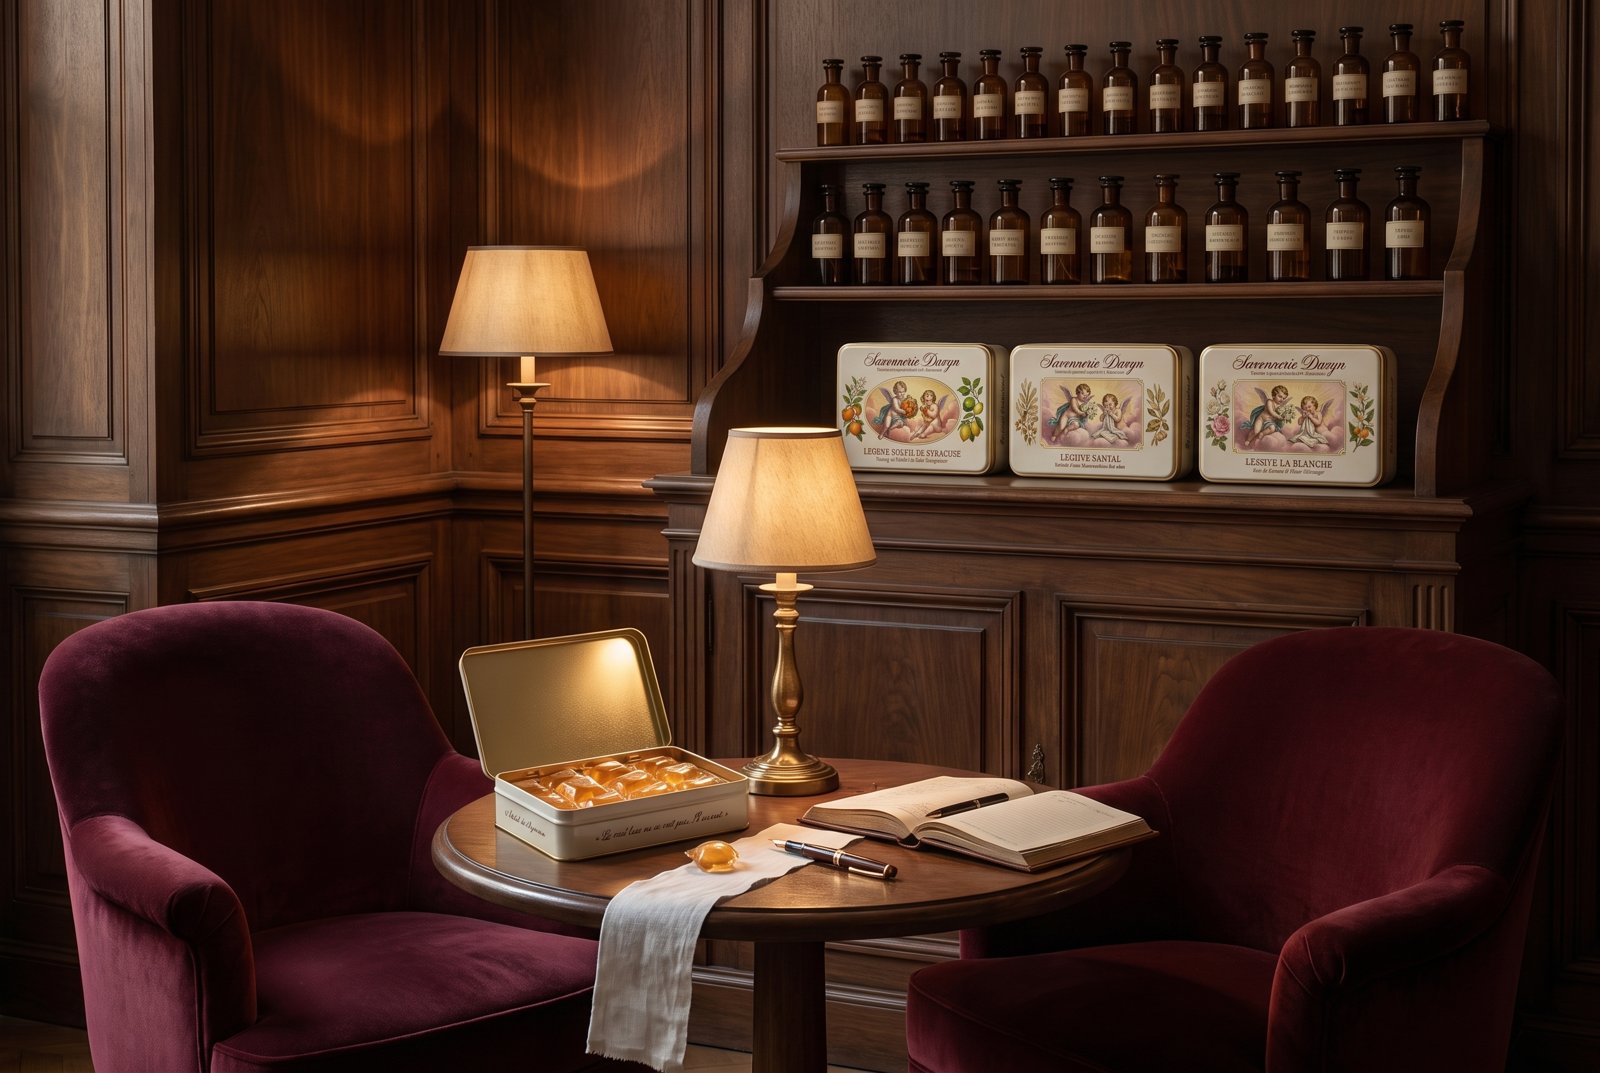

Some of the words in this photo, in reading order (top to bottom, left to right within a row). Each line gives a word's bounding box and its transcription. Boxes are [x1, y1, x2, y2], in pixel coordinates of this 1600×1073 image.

[916, 449, 925, 457] DE
[926, 449, 961, 458] SYRACUSE
[1092, 454, 1122, 463] SANTAL
[1280, 459, 1290, 467] LA
[1293, 460, 1332, 469] BLANCHE
